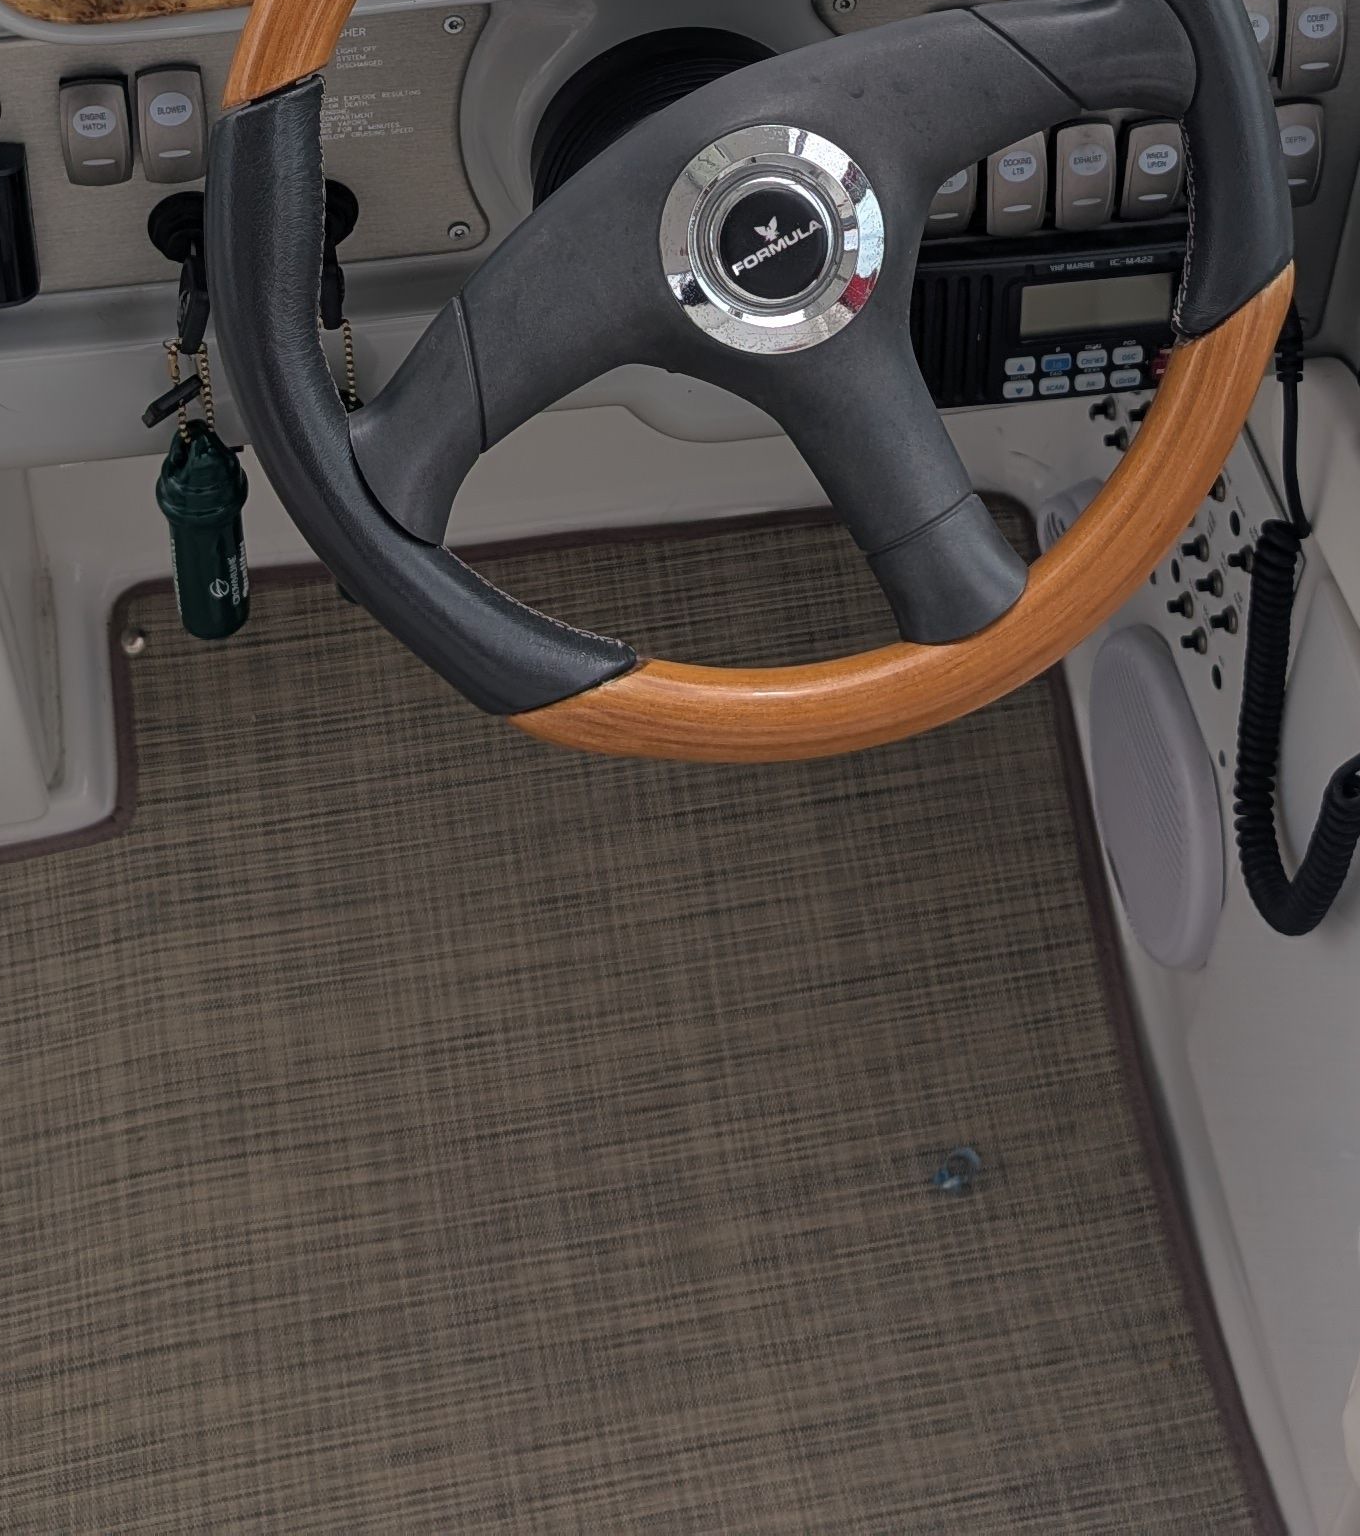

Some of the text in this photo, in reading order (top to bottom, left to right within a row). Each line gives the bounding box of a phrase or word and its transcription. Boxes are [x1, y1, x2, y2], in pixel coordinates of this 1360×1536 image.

[1306, 13, 1329, 23] COURT
[1311, 24, 1325, 33] LTS
[336, 47, 358, 55] LIGHT
[336, 54, 367, 62] SYSTEM
[381, 89, 422, 98] RESULTING
[156, 104, 187, 115] BLOWER
[79, 111, 107, 122] ENGINE
[82, 123, 107, 131] HATCH
[1284, 135, 1307, 144] DEPTH
[1003, 156, 1033, 167] DOCKING
[1073, 154, 1102, 165] EXHAUST
[1012, 167, 1025, 176] LTS
[731, 219, 823, 277] FORMULA
[1066, 261, 1095, 271] MARINE
[1045, 383, 1065, 392] SCAN
